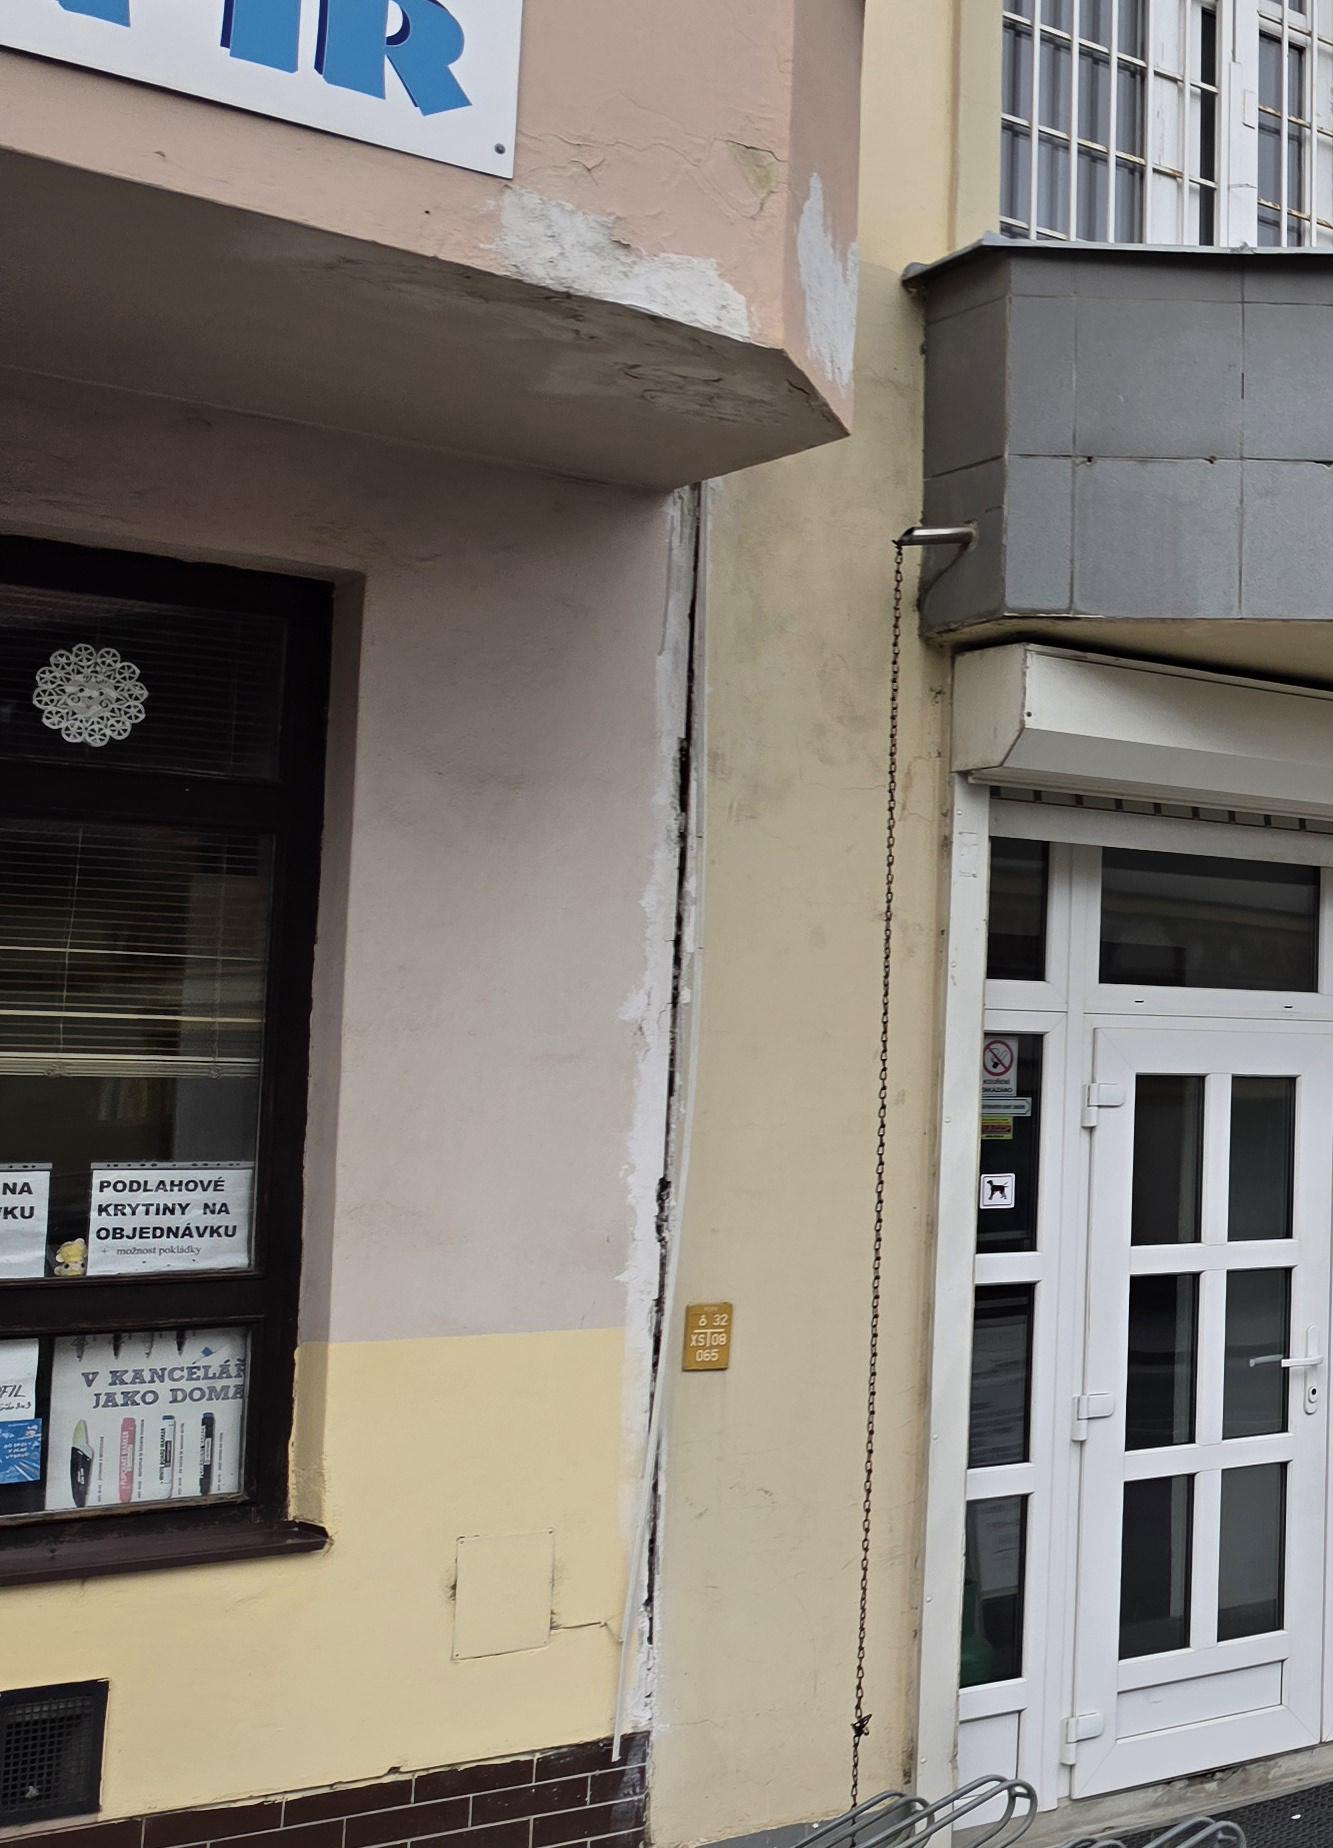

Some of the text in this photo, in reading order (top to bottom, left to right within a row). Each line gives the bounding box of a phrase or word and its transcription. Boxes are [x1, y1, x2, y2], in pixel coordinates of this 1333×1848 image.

[2, 1182, 33, 1195] NA
[99, 1177, 226, 1192] PODLAHOVÉ
[97, 1203, 230, 1217] KRYTINY NA
[96, 1223, 237, 1240] OBJEDNÁVKU
[117, 1246, 156, 1255] možnost
[713, 1313, 728, 1326] 32
[690, 1333, 726, 1347] XS 08
[696, 1349, 719, 1362] 065
[82, 1372, 99, 1387] V
[93, 1384, 244, 1409] JAKO DOMA
